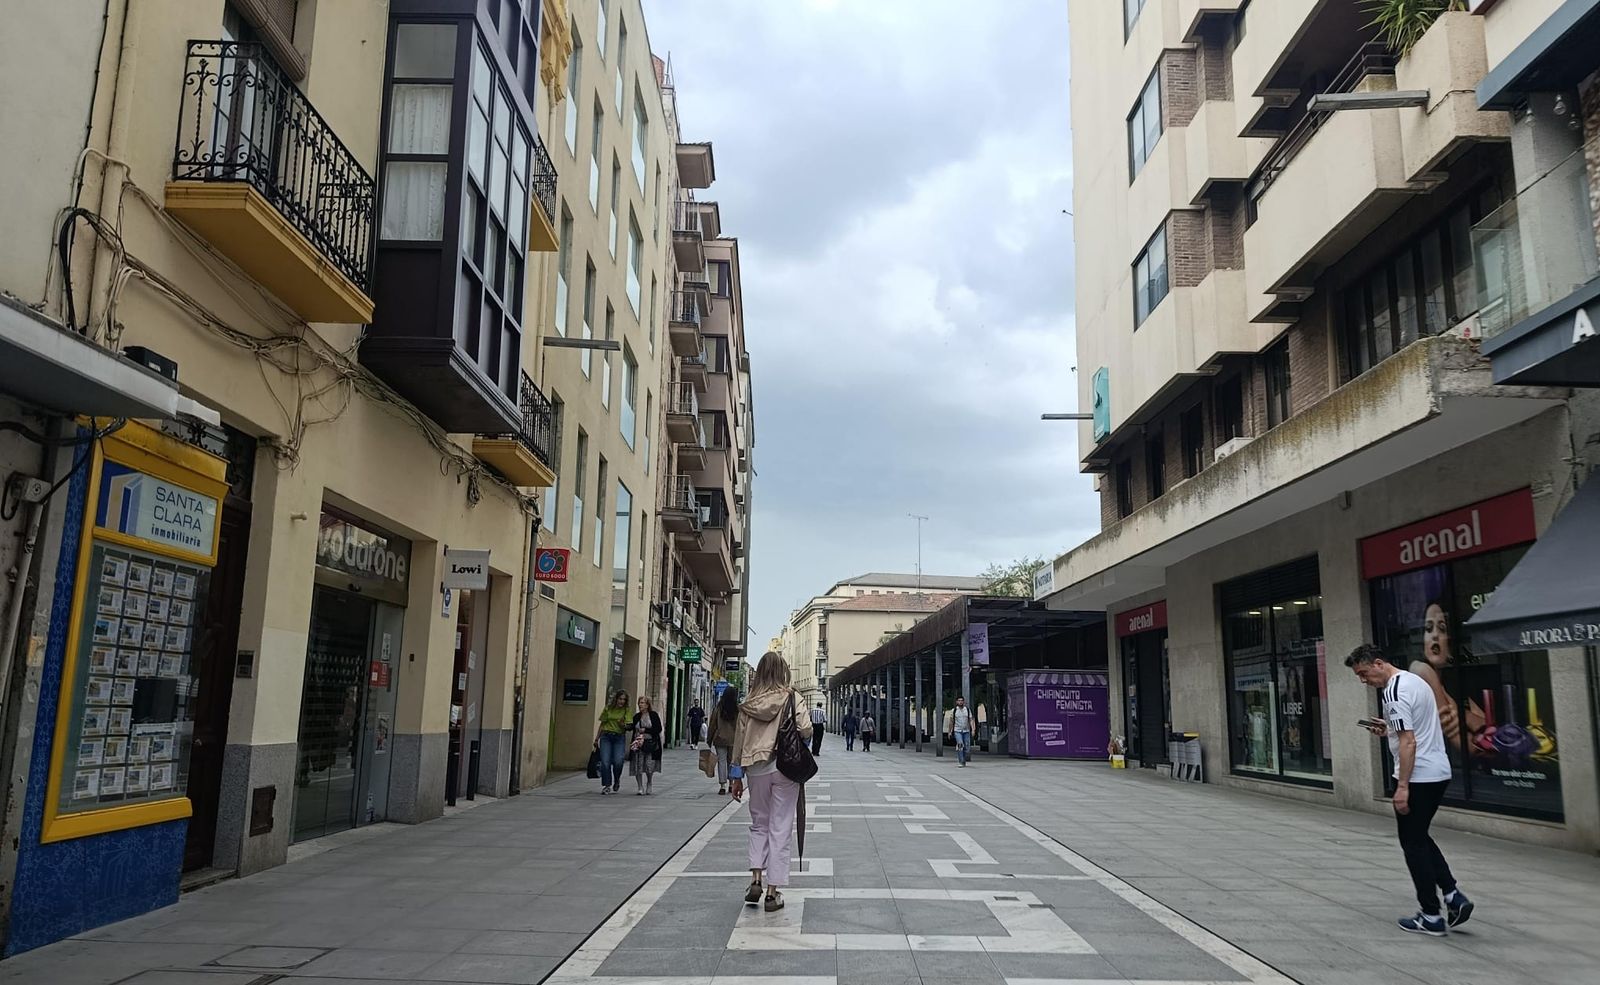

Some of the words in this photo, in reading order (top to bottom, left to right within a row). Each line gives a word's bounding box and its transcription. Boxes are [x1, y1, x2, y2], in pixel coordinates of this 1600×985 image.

[156, 486, 204, 515] SANTA
[153, 505, 202, 532] CLARA
[151, 523, 201, 547] inmobiliaria
[1400, 509, 1482, 564] arenal
[451, 564, 482, 574] Lowi
[1129, 607, 1154, 632] arenal
[1519, 627, 1573, 646] AURORA
[1056, 700, 1093, 711] FEMINISTA
[1283, 702, 1303, 715] LIBRE
